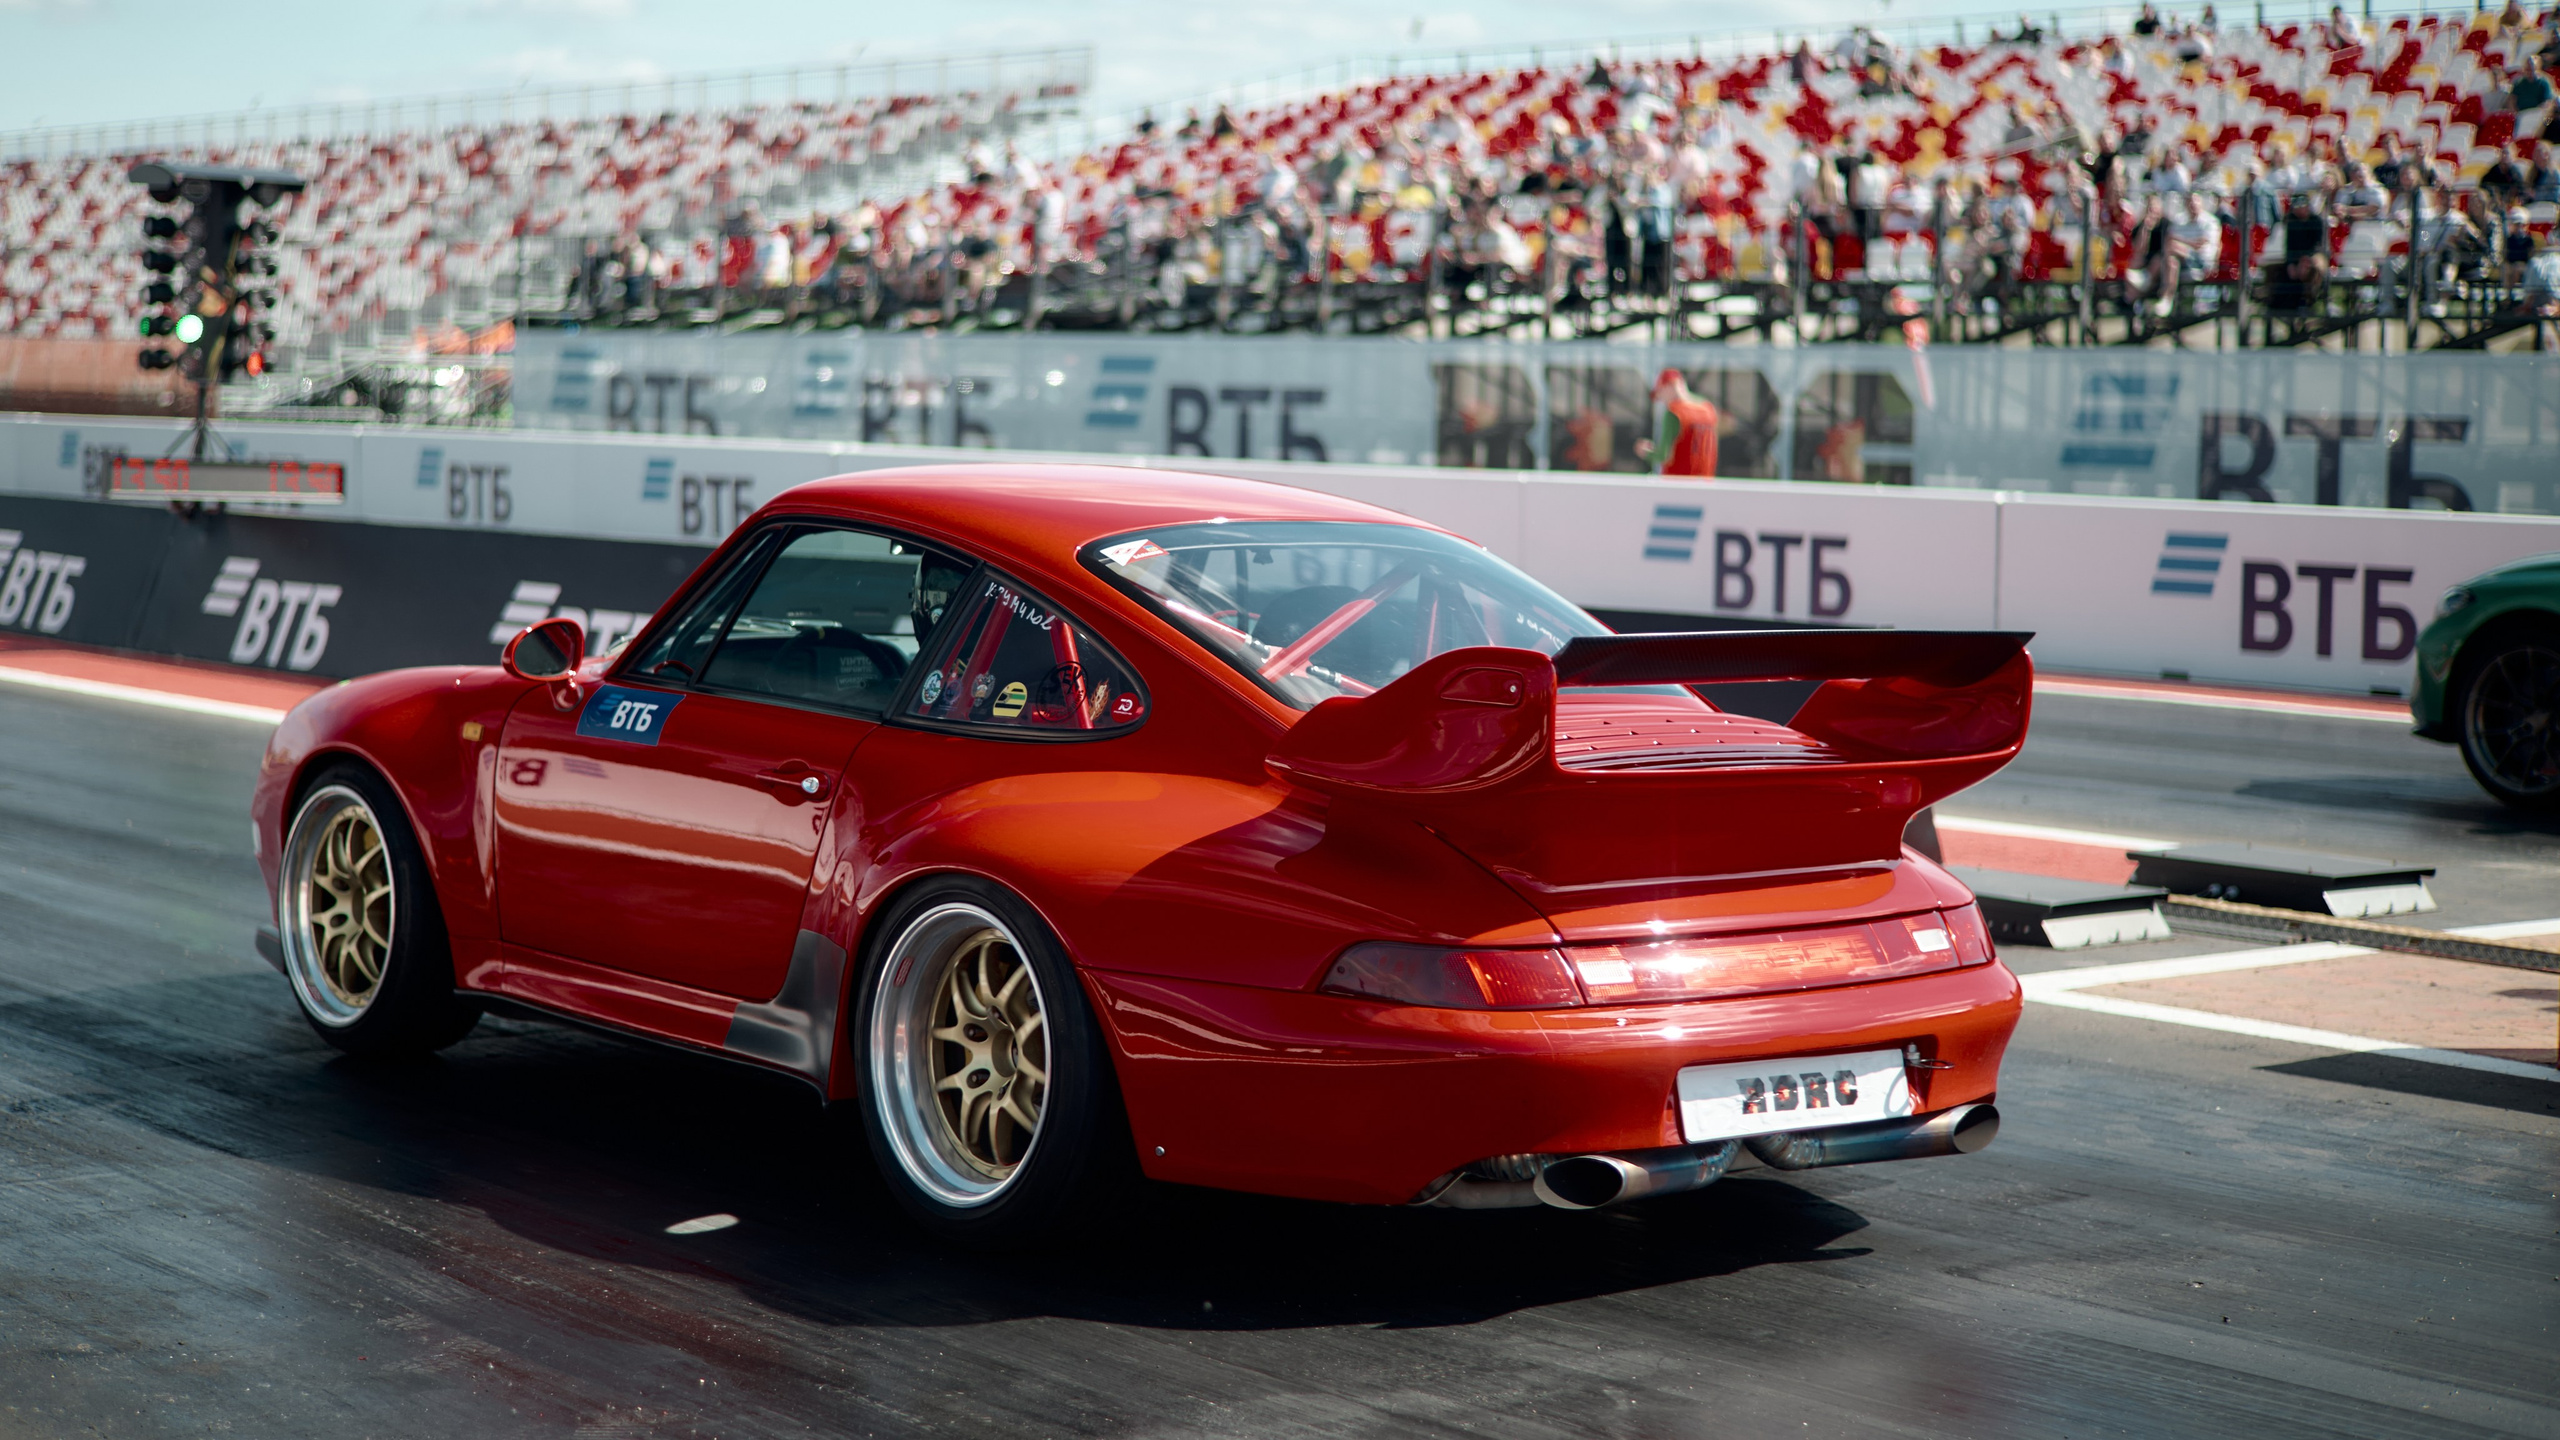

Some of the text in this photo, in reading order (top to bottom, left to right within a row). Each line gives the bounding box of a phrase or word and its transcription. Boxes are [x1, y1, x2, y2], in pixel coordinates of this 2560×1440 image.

[448, 464, 513, 522] ВТБ
[0, 548, 87, 635] ВТБ
[1713, 528, 1854, 618] ВТБ
[2239, 558, 2418, 664] ВТБ
[230, 578, 344, 672] ВТБ
[610, 700, 660, 732] ВТБ
